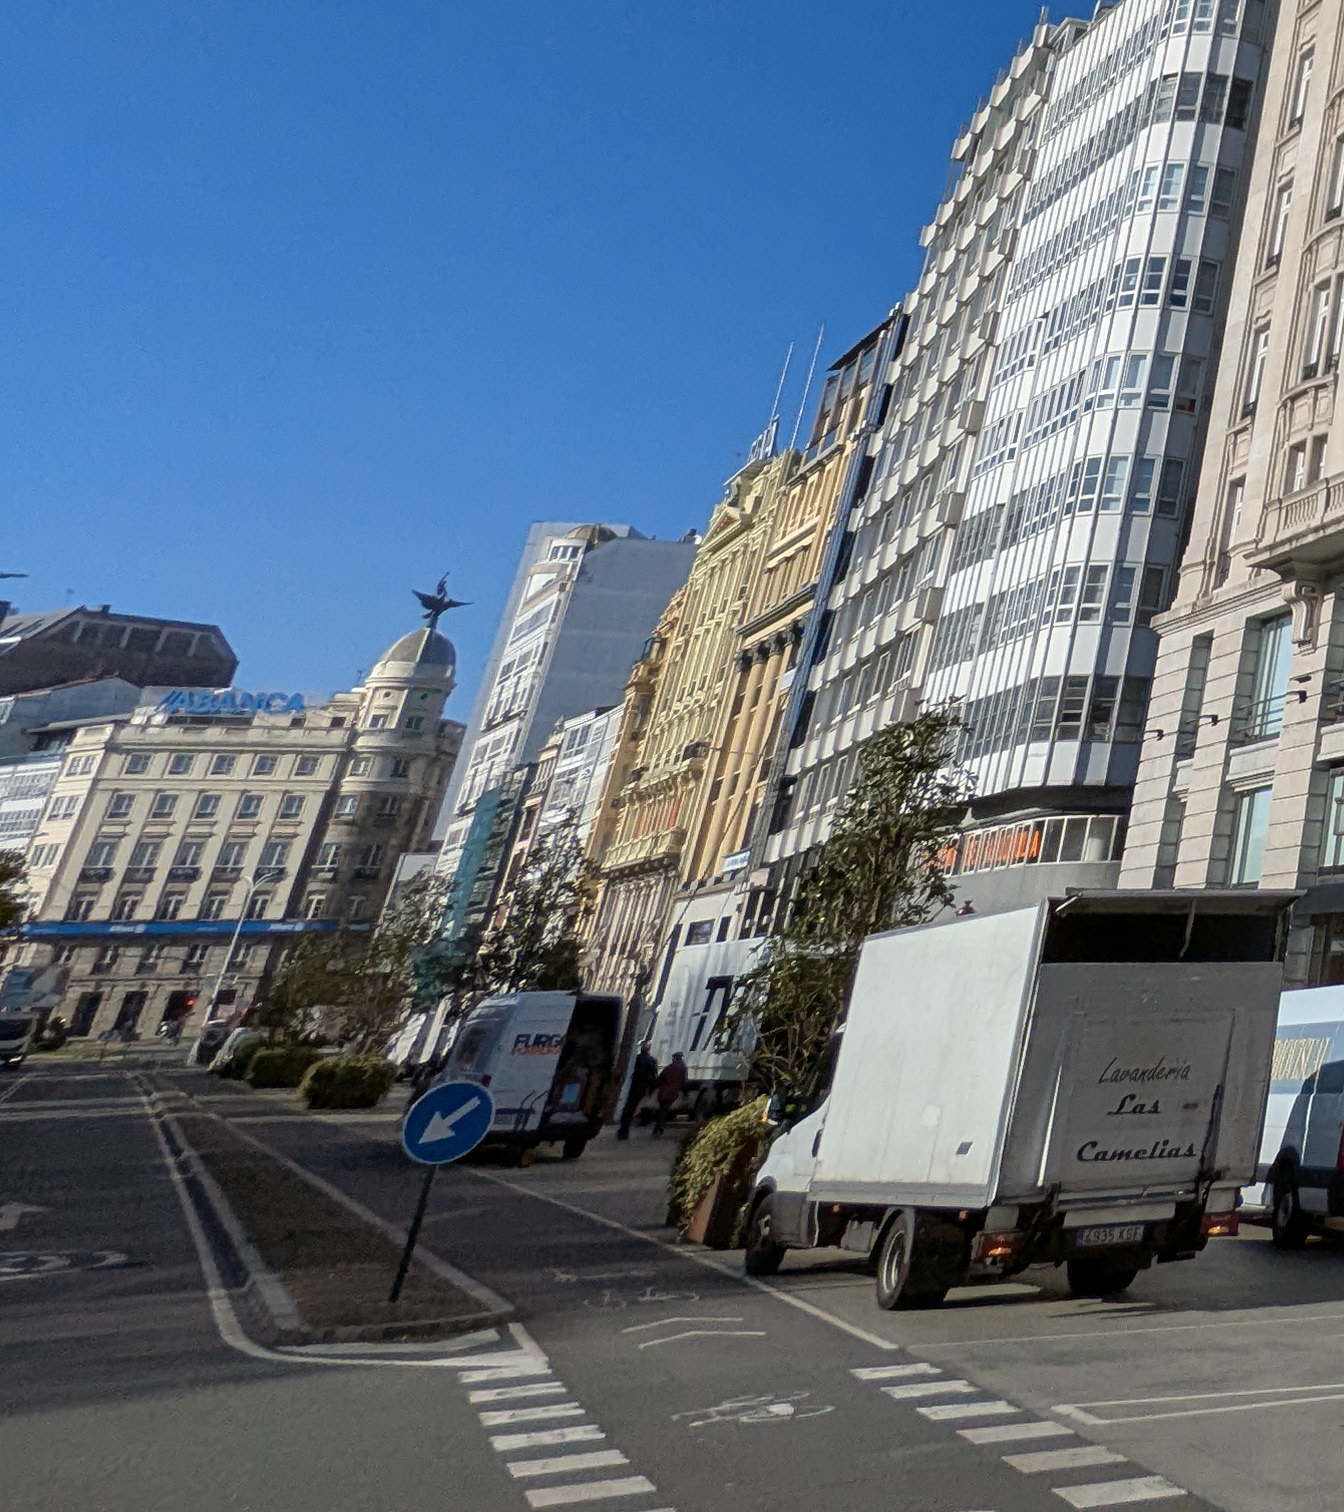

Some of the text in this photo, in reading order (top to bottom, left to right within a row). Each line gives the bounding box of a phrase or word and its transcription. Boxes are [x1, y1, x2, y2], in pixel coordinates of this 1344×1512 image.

[163, 690, 305, 715] ABANCA
[1098, 1056, 1192, 1084] Lavandería
[1106, 1093, 1161, 1115] Las
[1077, 1139, 1197, 1162] Camelias
